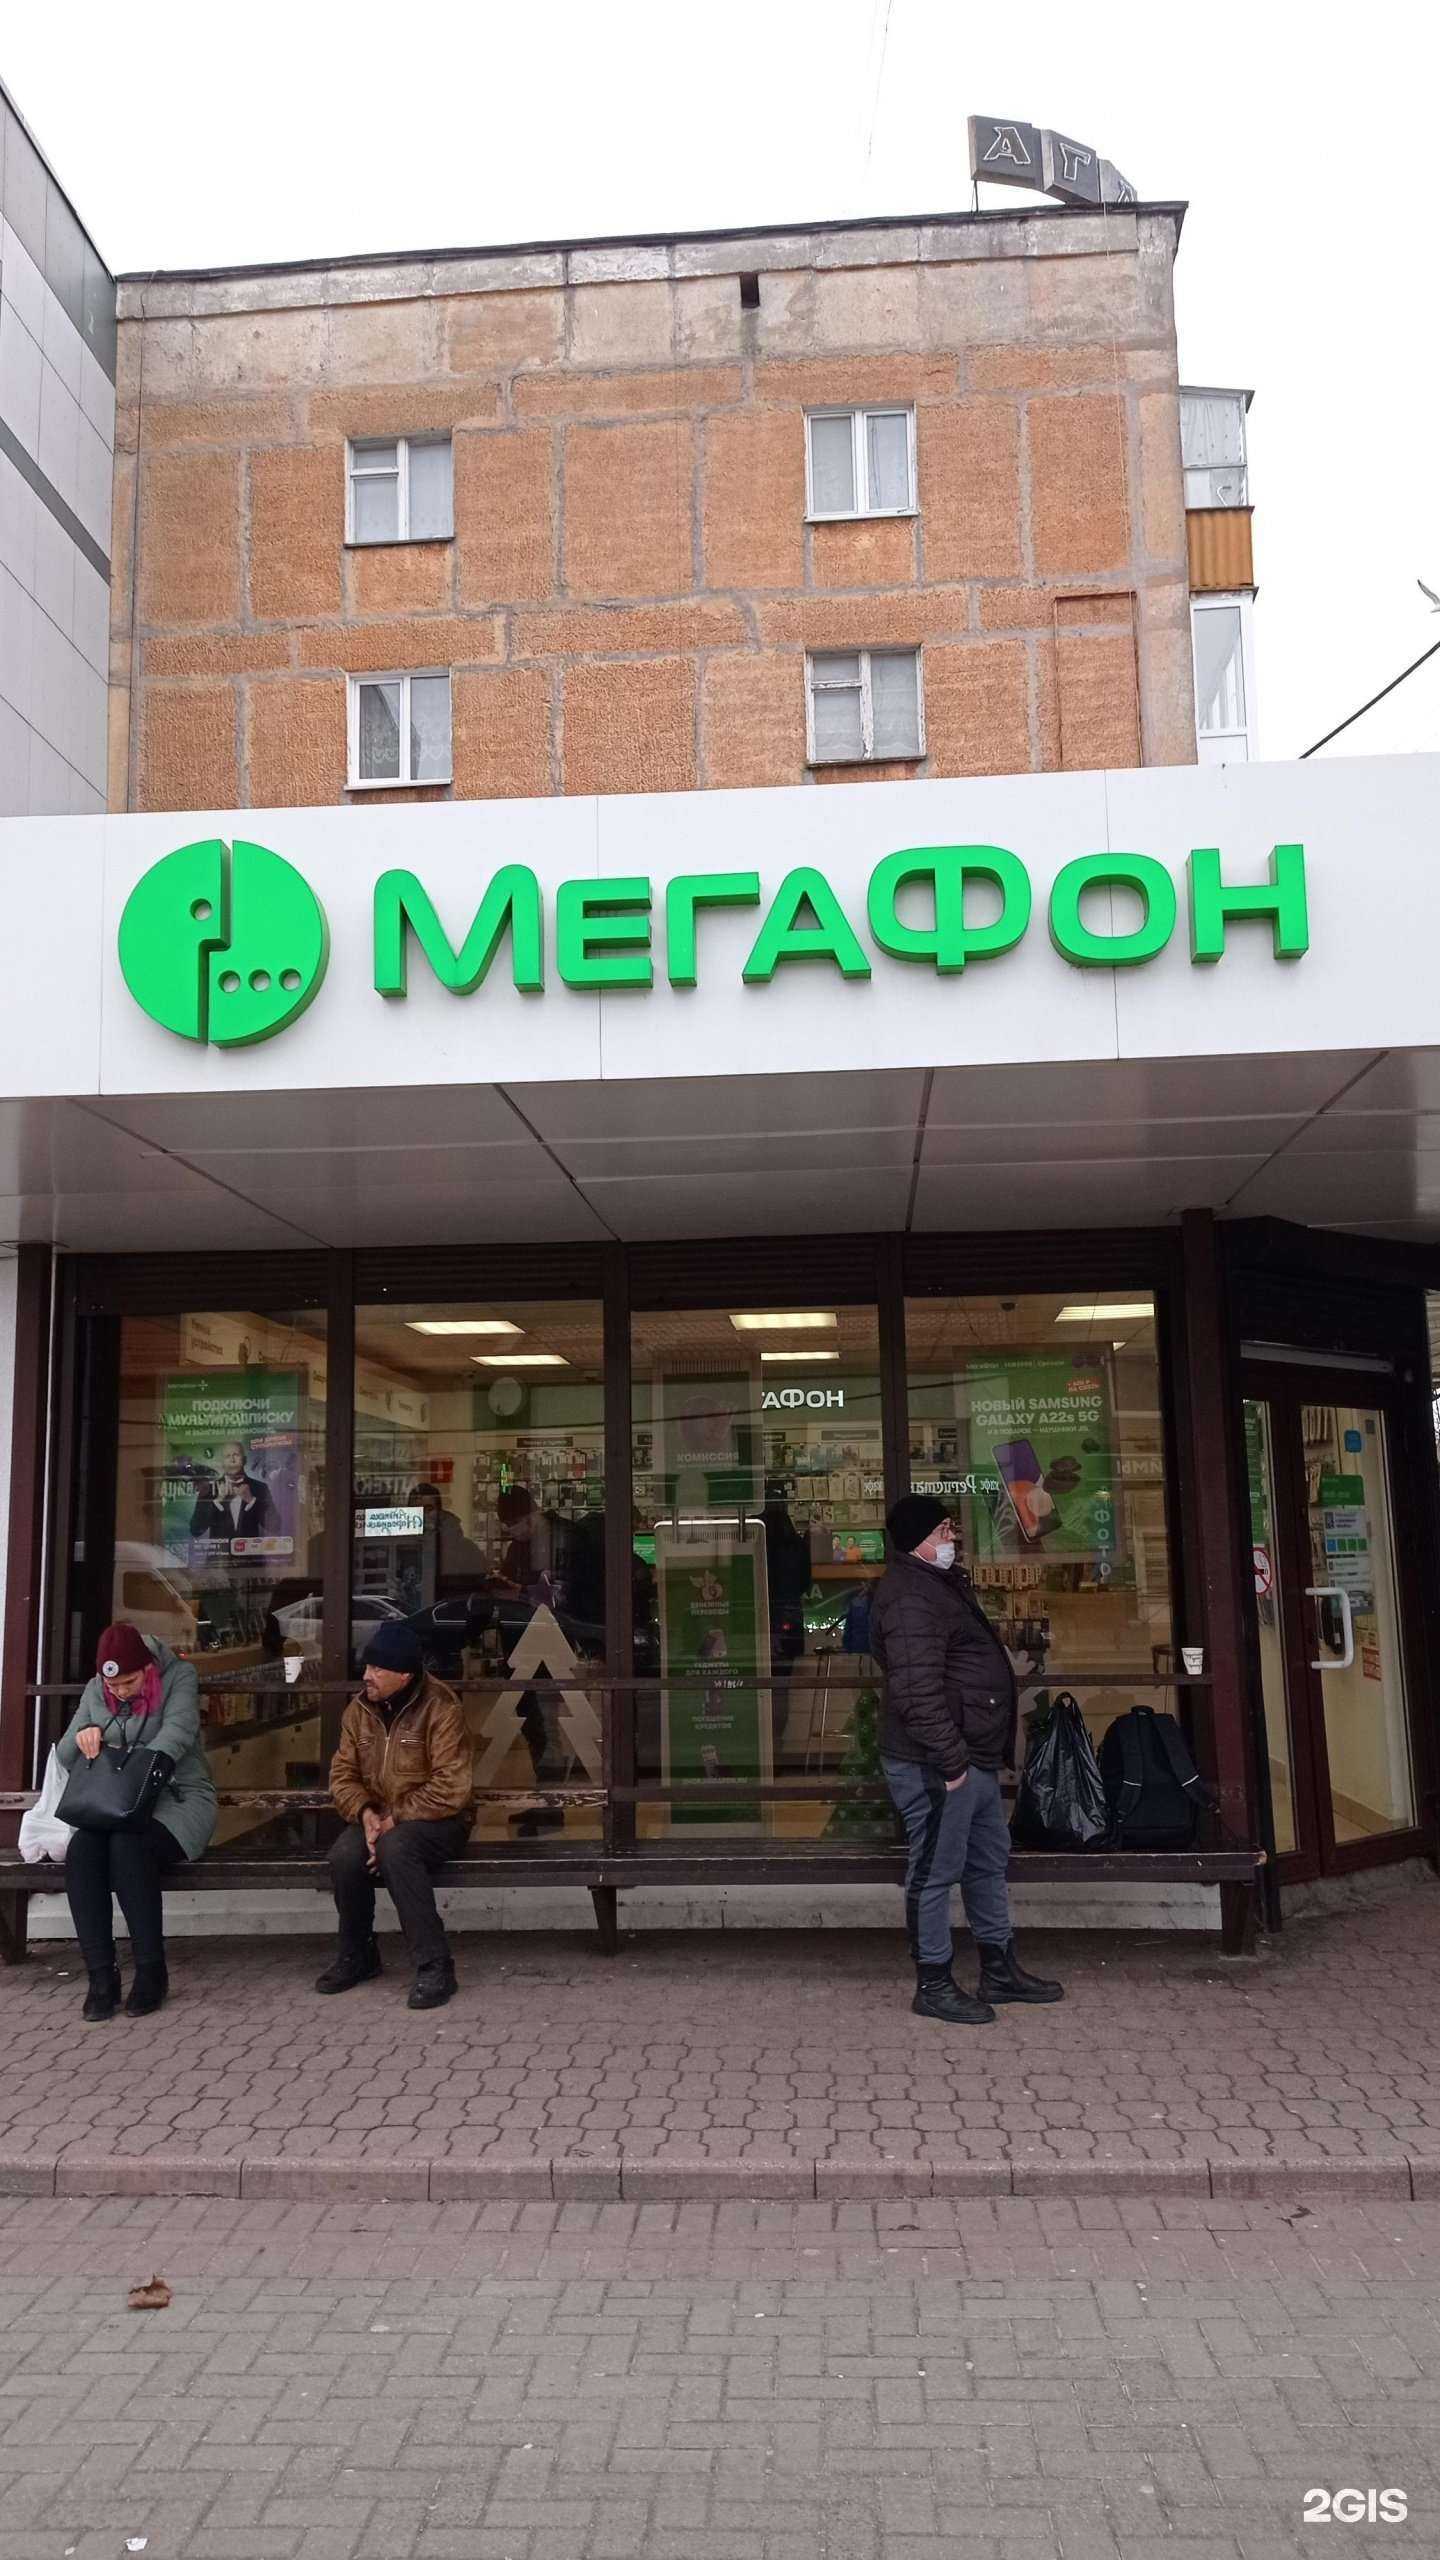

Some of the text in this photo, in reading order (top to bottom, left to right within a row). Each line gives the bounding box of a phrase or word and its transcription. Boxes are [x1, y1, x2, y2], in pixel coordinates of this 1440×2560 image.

[374, 843, 1309, 998] МЕГАФОН
[192, 1398, 271, 1413] ПОДКЛЮЧИ
[971, 1395, 1103, 1412] НОВЫЙ SAMSUNG
[976, 1409, 1101, 1426] GALAXY A22s 5G
